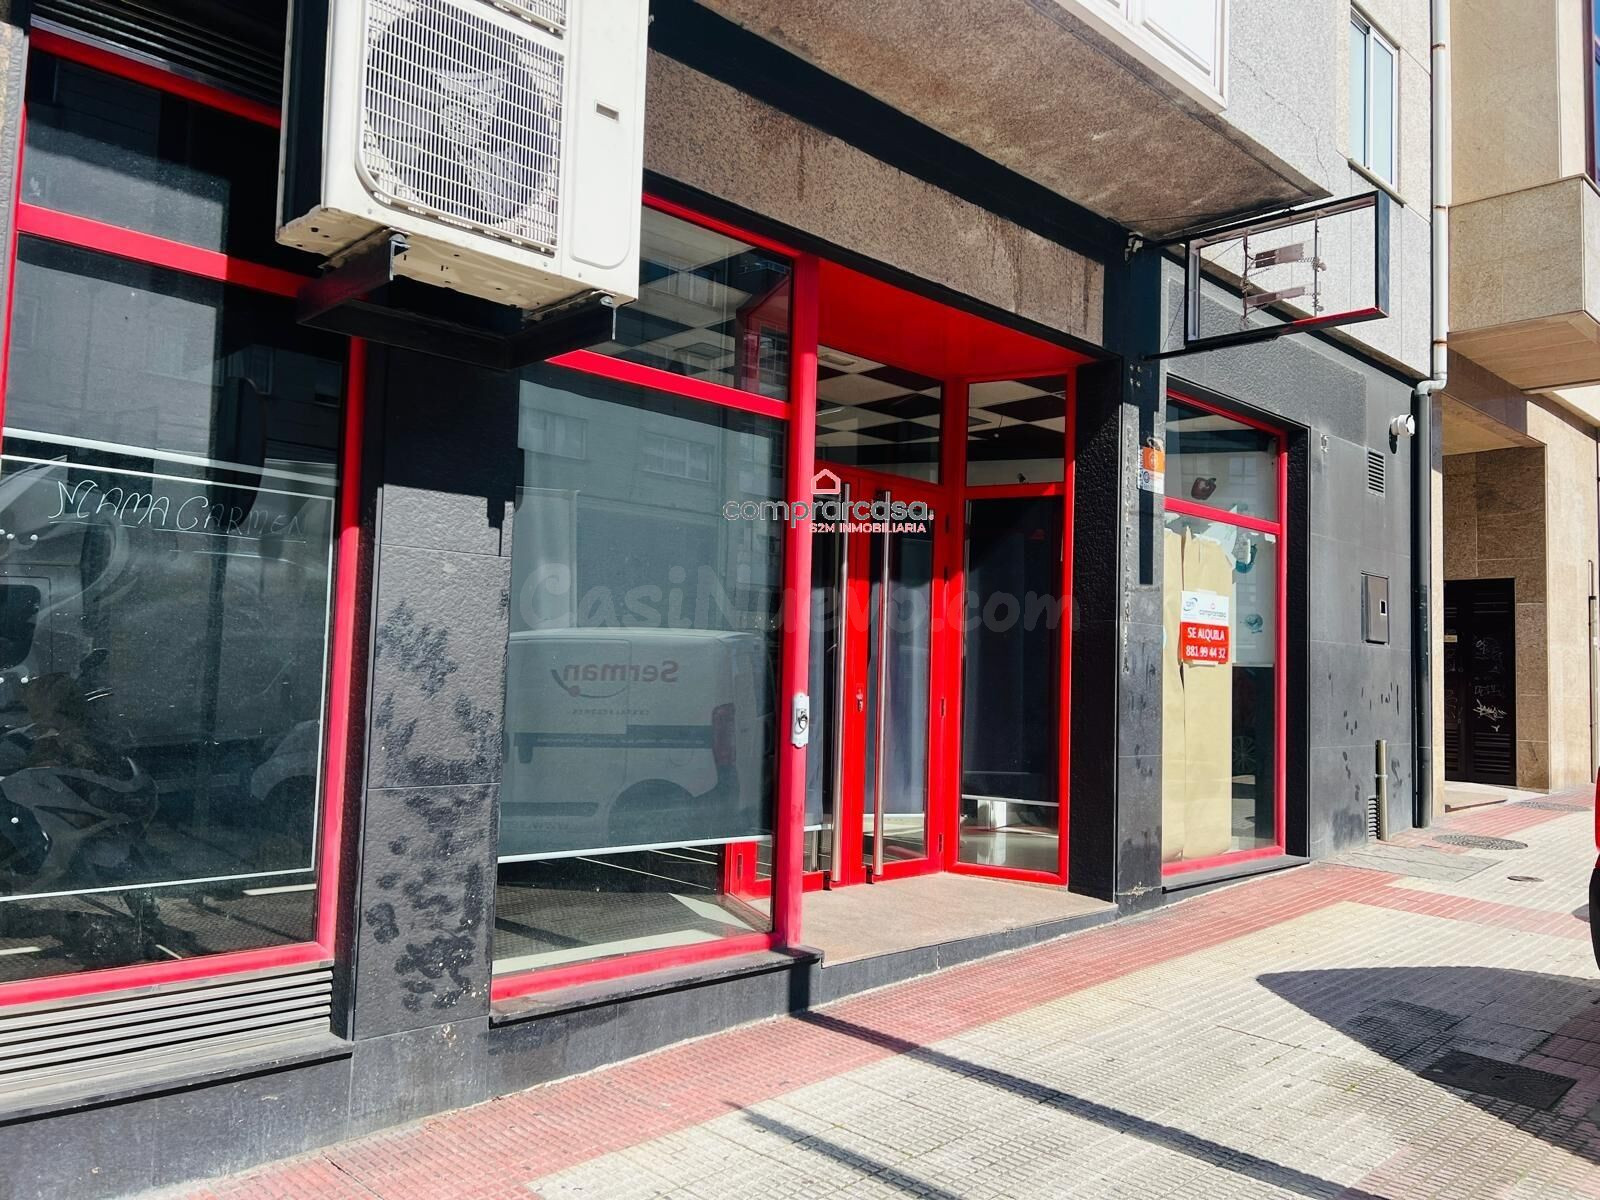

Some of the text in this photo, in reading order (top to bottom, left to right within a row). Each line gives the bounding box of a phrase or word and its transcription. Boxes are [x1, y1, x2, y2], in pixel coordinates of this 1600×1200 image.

[1187, 627, 1225, 642] SE ALQUILA
[1186, 645, 1226, 659] 881 99 44 32
